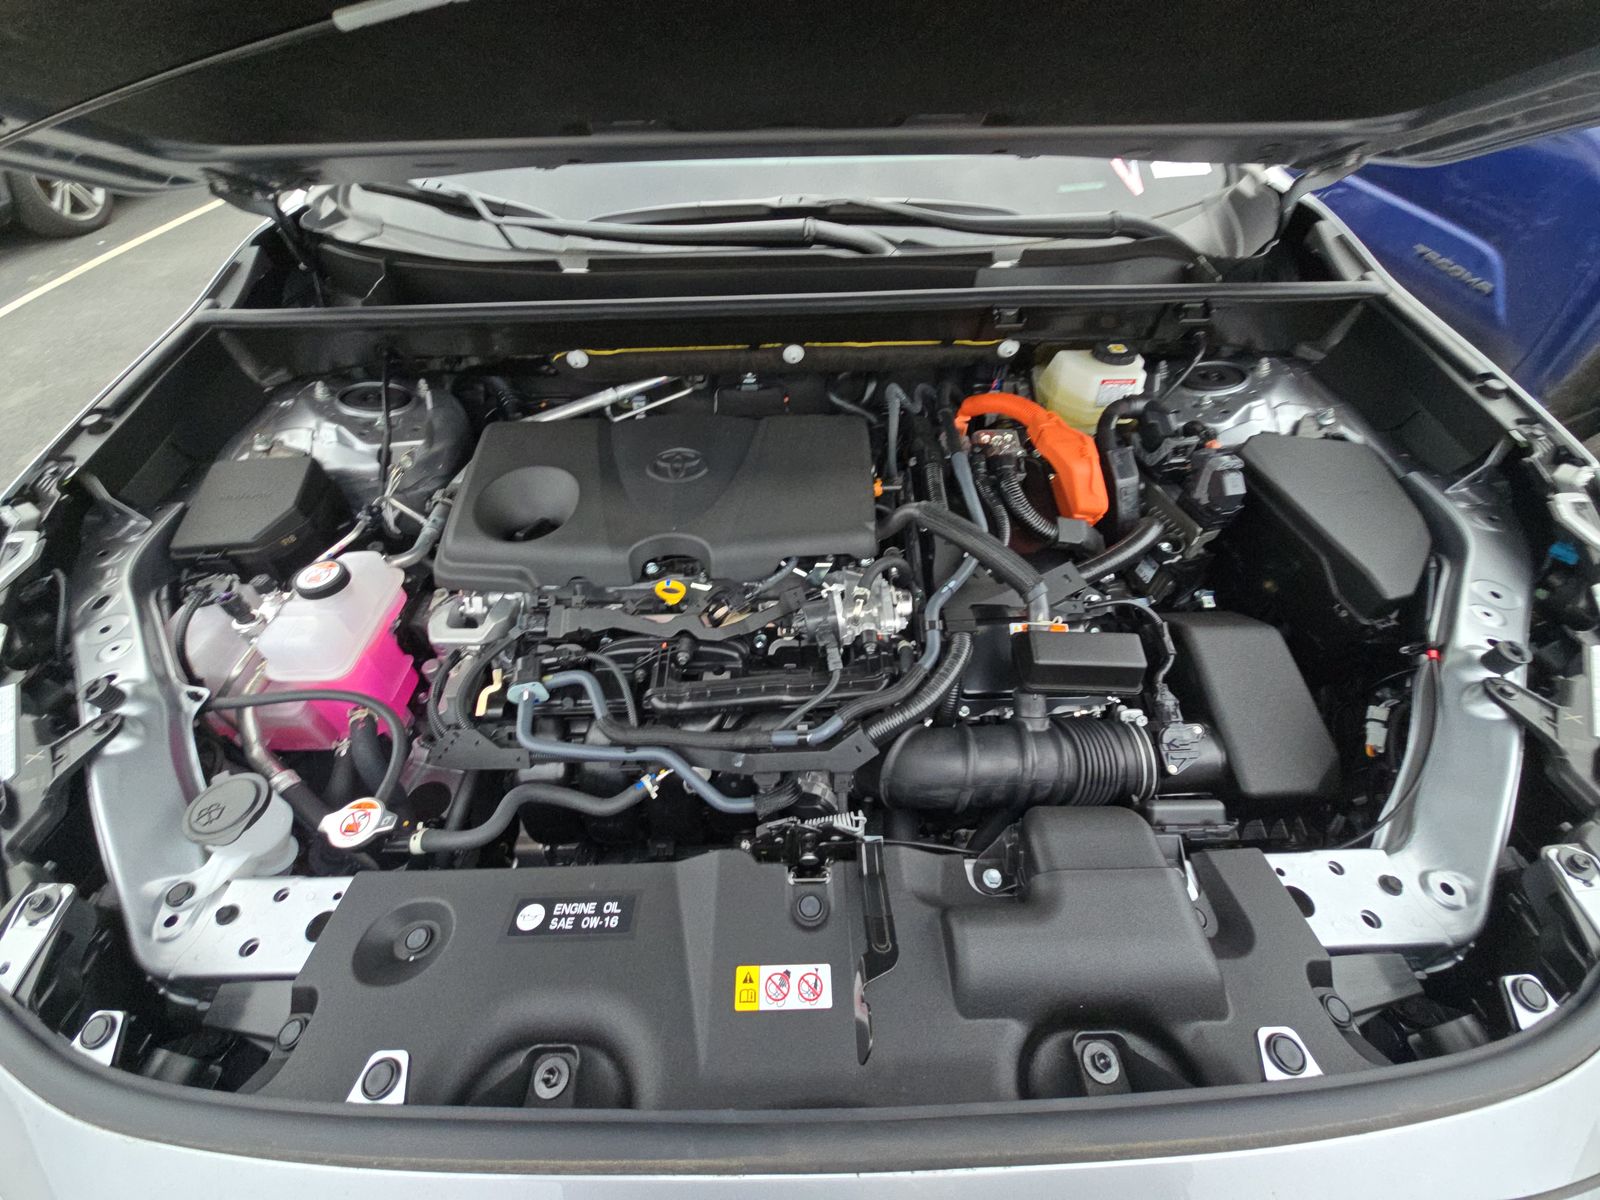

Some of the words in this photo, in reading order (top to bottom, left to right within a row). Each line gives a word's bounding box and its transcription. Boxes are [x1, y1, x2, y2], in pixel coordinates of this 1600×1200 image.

[1413, 243, 1494, 295] TACOMA
[553, 902, 597, 915] ENGINE
[603, 901, 621, 914] OIL
[549, 916, 575, 930] SAE
